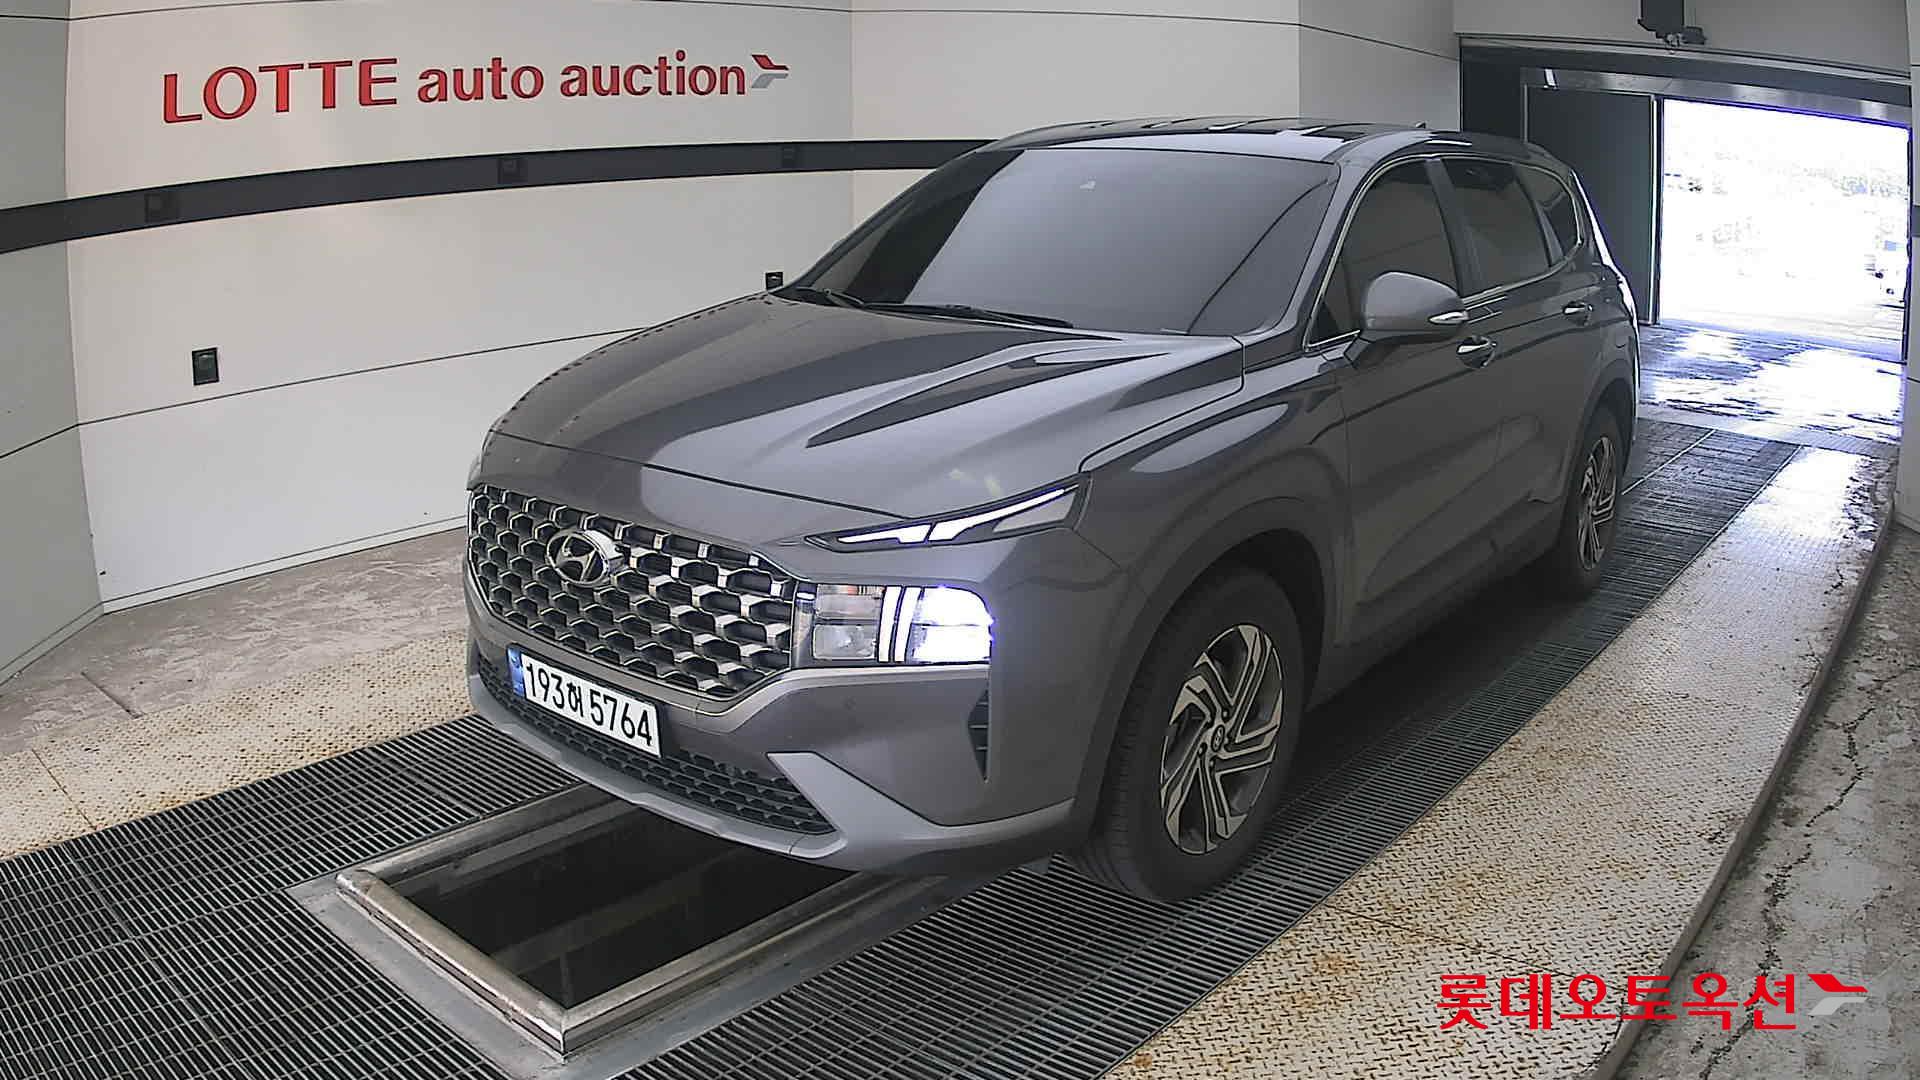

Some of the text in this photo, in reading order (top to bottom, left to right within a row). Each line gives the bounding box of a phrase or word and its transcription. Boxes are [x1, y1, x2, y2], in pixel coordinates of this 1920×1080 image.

[163, 49, 746, 124] LOTTE auto auction
